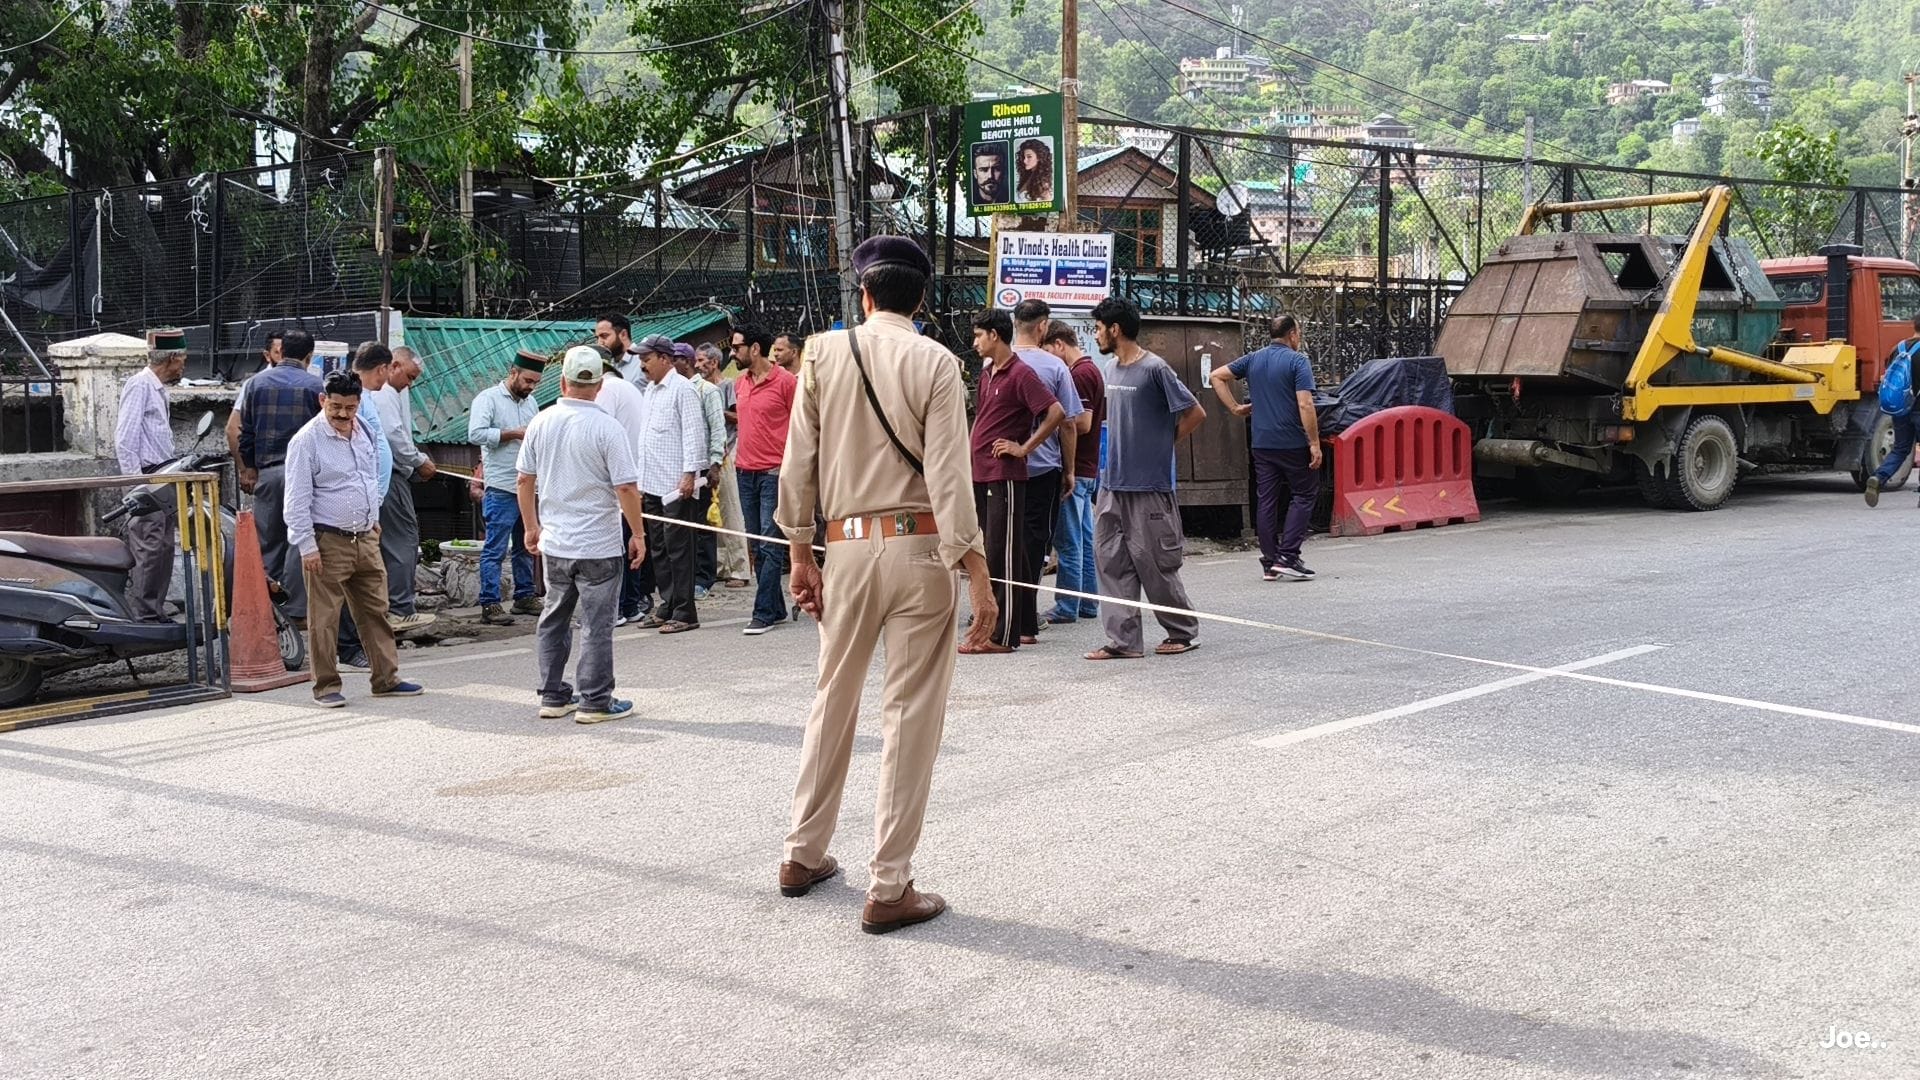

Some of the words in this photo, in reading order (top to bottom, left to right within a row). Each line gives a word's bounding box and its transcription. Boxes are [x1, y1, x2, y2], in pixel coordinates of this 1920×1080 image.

[992, 104, 1031, 117] Rihaan
[981, 118, 1012, 129] UNIQUE
[1013, 116, 1034, 127] HAIR
[1036, 115, 1042, 124] &
[981, 129, 1013, 140] BEAUTY
[1014, 127, 1040, 137] SALON
[1002, 237, 1015, 255] Dr.
[1018, 238, 1049, 256] Vinod's
[1051, 238, 1080, 257] Health
[1082, 239, 1107, 258] Clinic
[1024, 291, 1047, 299] DENTAL
[1047, 292, 1072, 300] FACILITY
[1073, 292, 1105, 301] AVAILABLE
